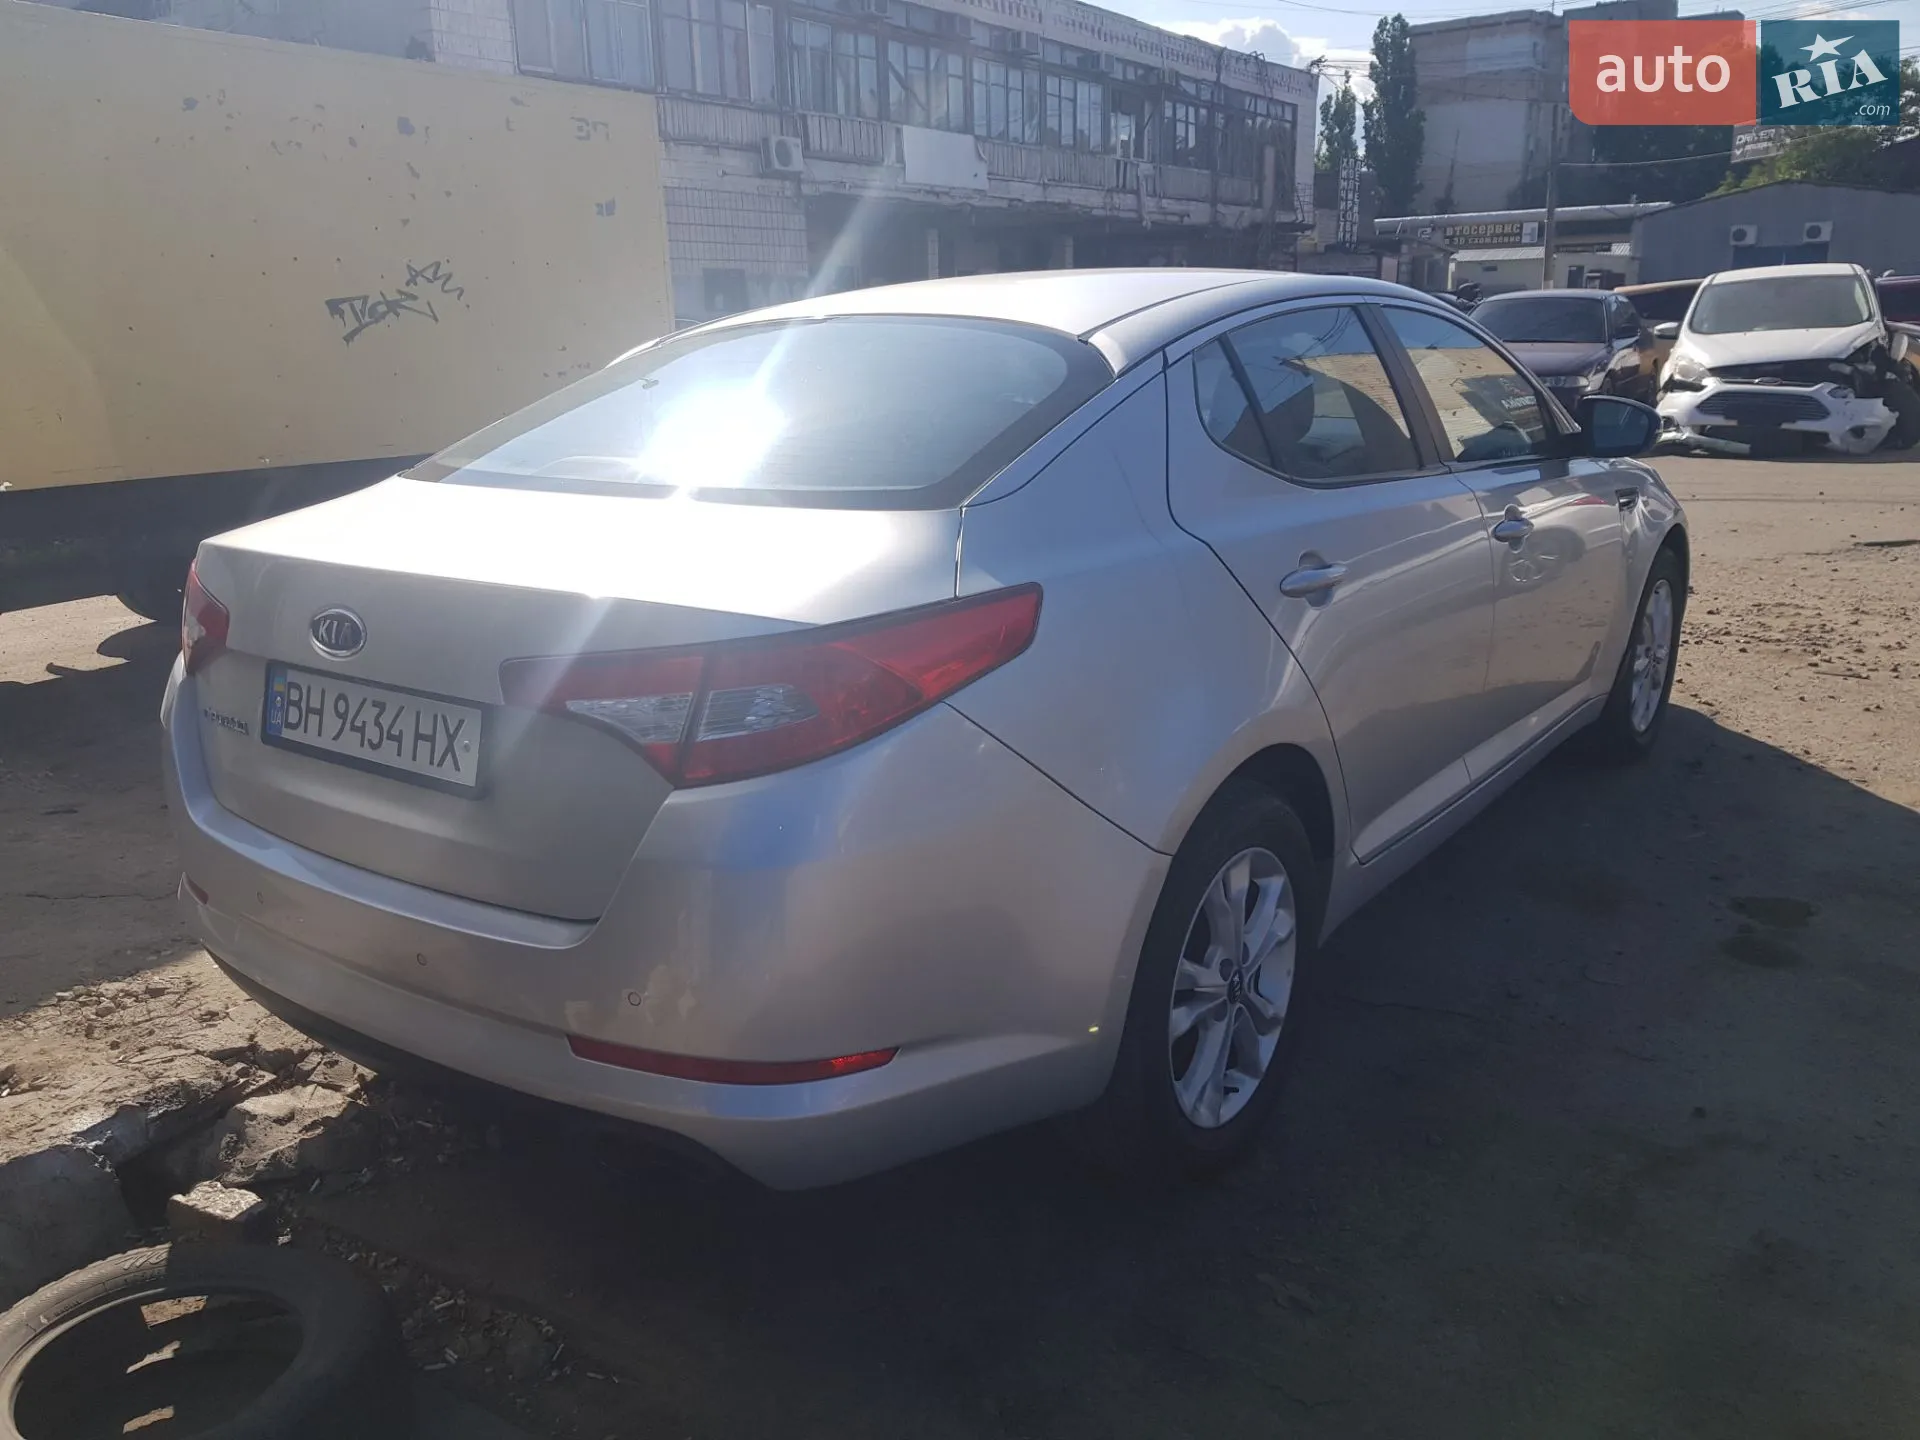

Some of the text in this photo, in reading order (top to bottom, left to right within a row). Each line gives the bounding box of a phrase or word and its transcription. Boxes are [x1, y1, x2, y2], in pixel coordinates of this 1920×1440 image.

[1338, 158, 1348, 242] ХИМЧИСТК
[1446, 223, 1521, 237] втосервис
[318, 618, 353, 646] KIA
[271, 710, 283, 727] UA
[283, 681, 327, 738] BH
[331, 692, 406, 758] 9434
[411, 709, 466, 773] HX
